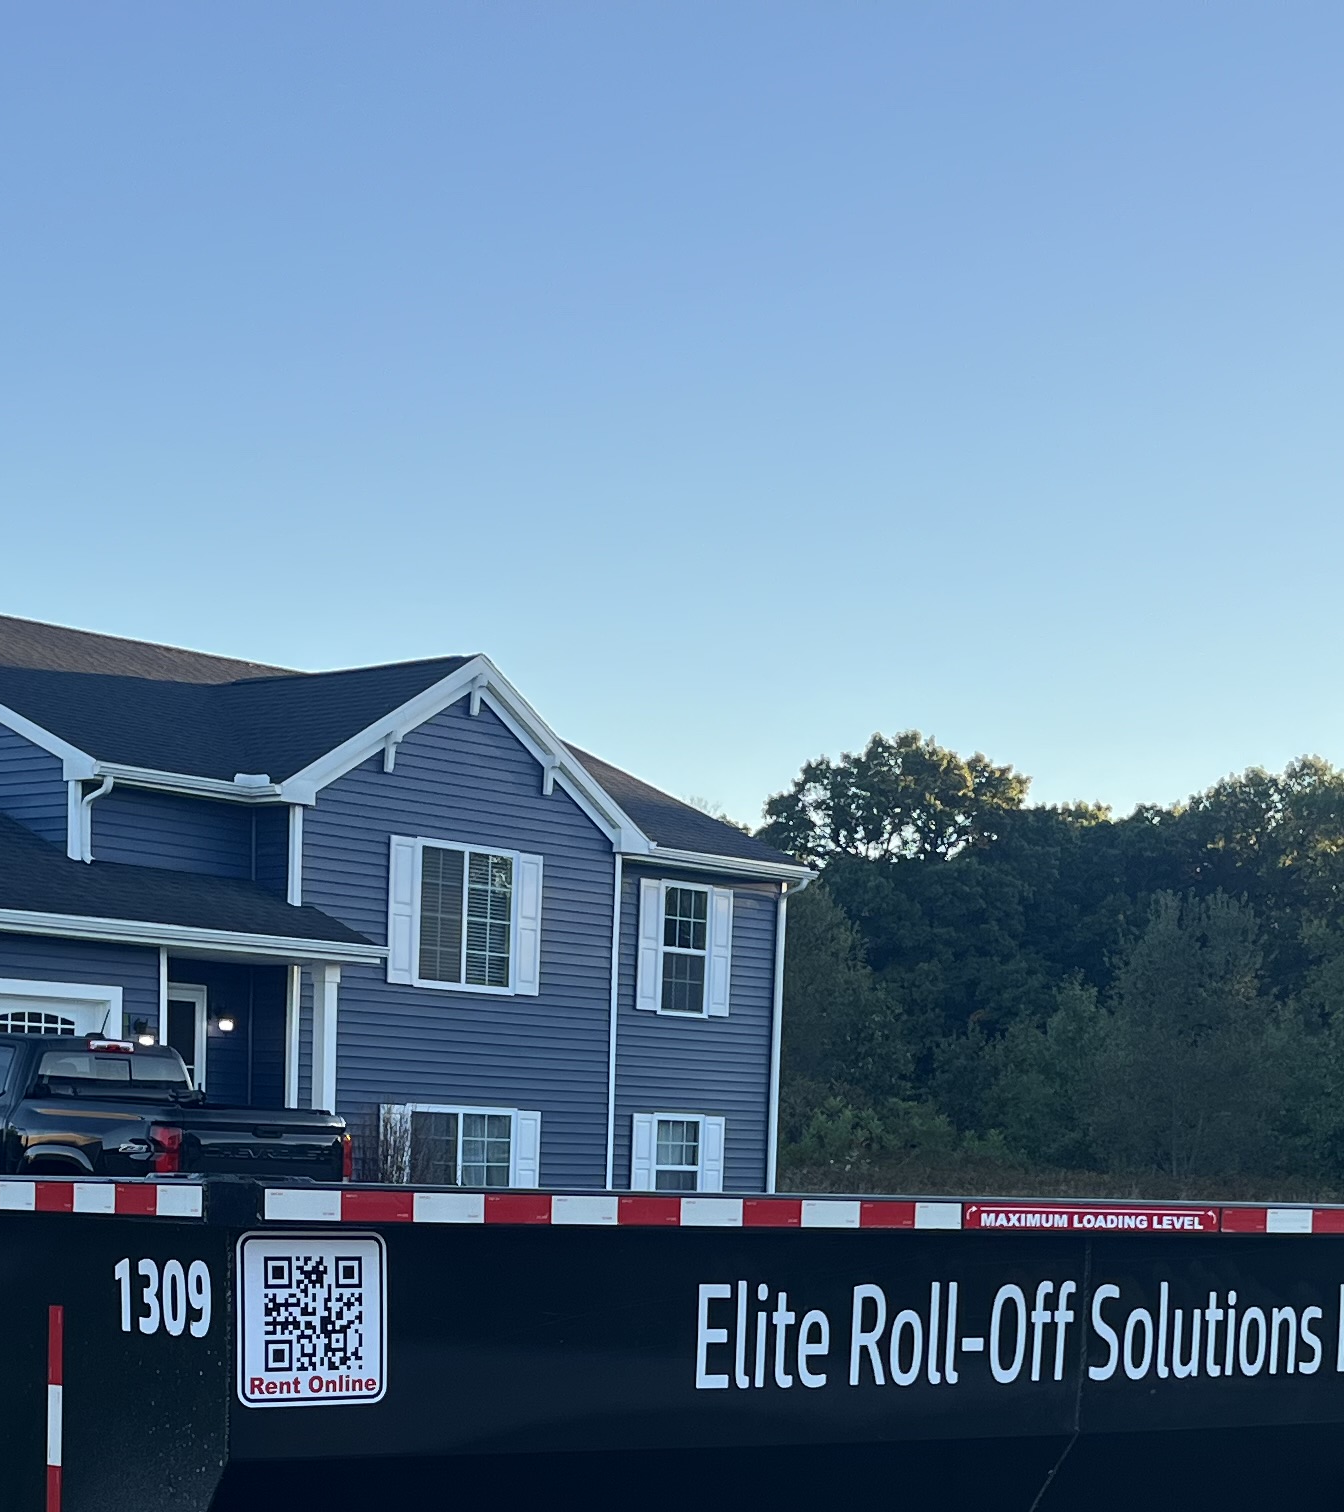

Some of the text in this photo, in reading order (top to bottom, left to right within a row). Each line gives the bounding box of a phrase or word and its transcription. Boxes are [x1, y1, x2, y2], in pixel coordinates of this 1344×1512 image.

[980, 1213, 1204, 1230] MAXIMUM LOADING LEVEL
[114, 1258, 211, 1338] 1309
[696, 1280, 830, 1389] Elite
[849, 1280, 1076, 1387] Roll-Off
[1088, 1281, 1323, 1381] Solutions
[249, 1375, 377, 1395] Rent Online
